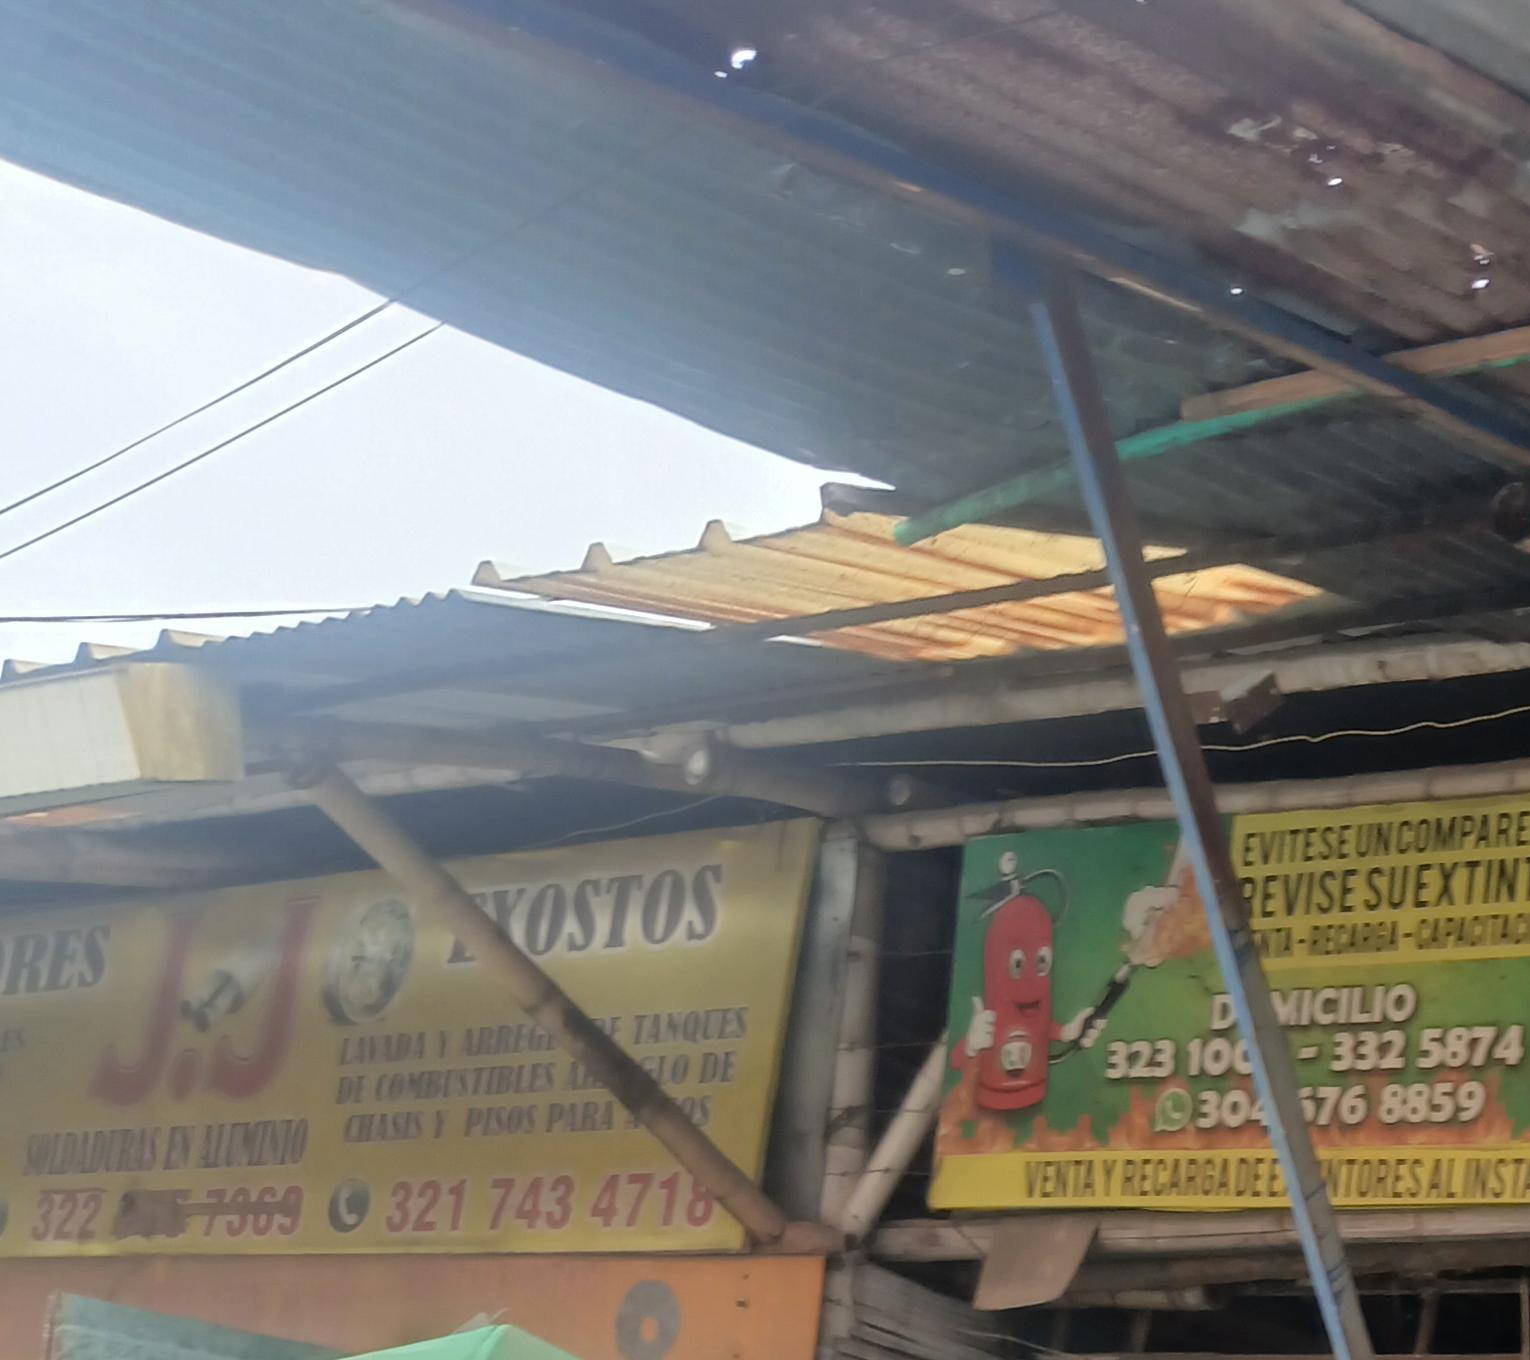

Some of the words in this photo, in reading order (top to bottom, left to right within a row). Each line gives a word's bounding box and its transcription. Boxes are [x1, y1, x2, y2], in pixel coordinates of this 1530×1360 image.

[1242, 824, 1353, 867] EVITESE
[1354, 821, 1394, 858] UN
[1239, 868, 1359, 918] REVISE
[1365, 864, 1411, 912] SU
[0, 925, 110, 995] RES
[1209, 984, 1417, 1031] DMICILIO
[461, 1023, 557, 1057] ARREGL
[633, 1007, 749, 1045] TANQUES
[1105, 1040, 1177, 1079] 323
[1330, 1030, 1406, 1072] 332
[1416, 1024, 1525, 1069] 5874
[699, 1051, 737, 1084] DE
[1379, 1081, 1486, 1126] 8859
[1025, 1159, 1095, 1198] VENTA
[1102, 1158, 1117, 1197] Y
[1120, 1158, 1231, 1197] RECARGA
[1235, 1157, 1265, 1198] DE
[386, 1179, 467, 1233] 321
[489, 1174, 576, 1230] 743
